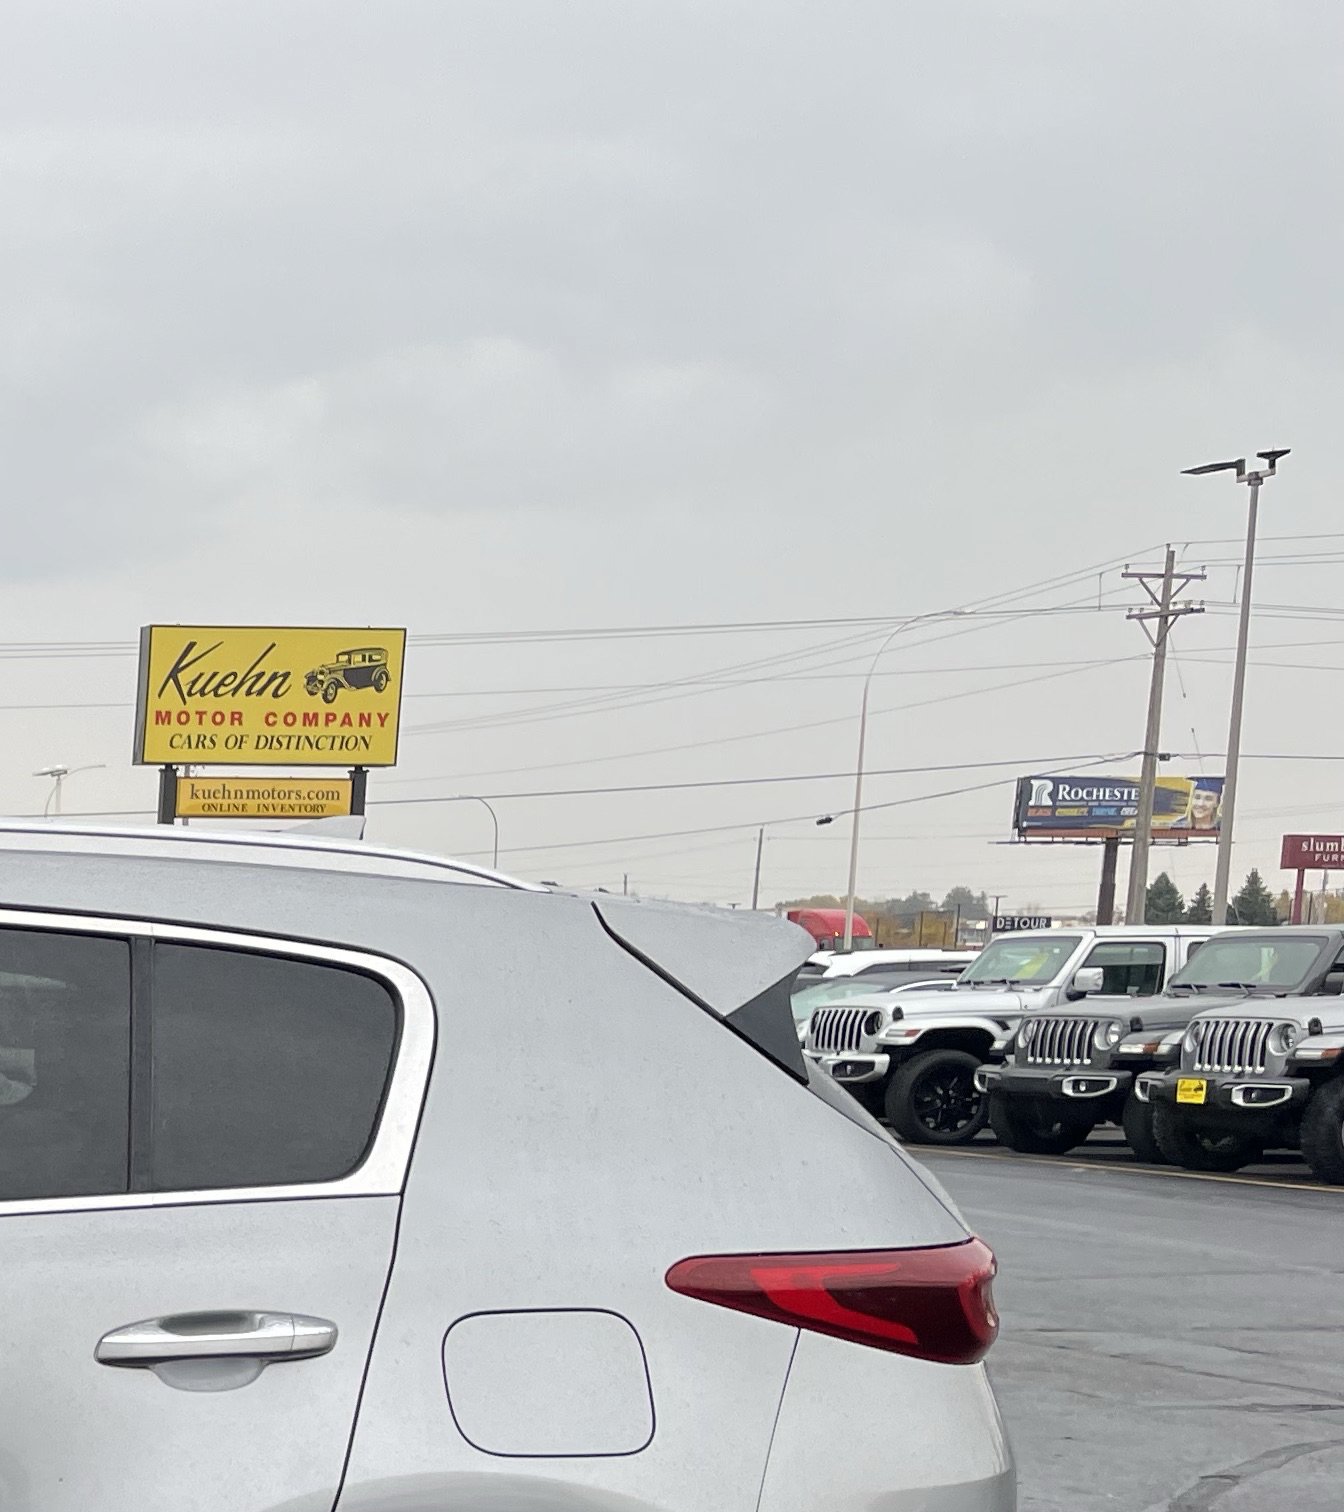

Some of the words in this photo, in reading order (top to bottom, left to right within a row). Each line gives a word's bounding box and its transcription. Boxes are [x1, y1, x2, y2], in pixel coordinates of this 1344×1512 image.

[157, 641, 292, 706] Kuehn
[154, 710, 244, 726] MOTOR
[264, 711, 390, 728] COMPANY
[169, 733, 217, 750] CARS
[224, 734, 248, 750] OF
[254, 734, 373, 751] DISTINCTION
[190, 783, 340, 801] kuehnmotors.com
[1057, 784, 1140, 800] ROCHESTE
[201, 803, 248, 813] ONLINE
[256, 803, 326, 814] INVENTORY
[996, 917, 1047, 929] DETOUR
